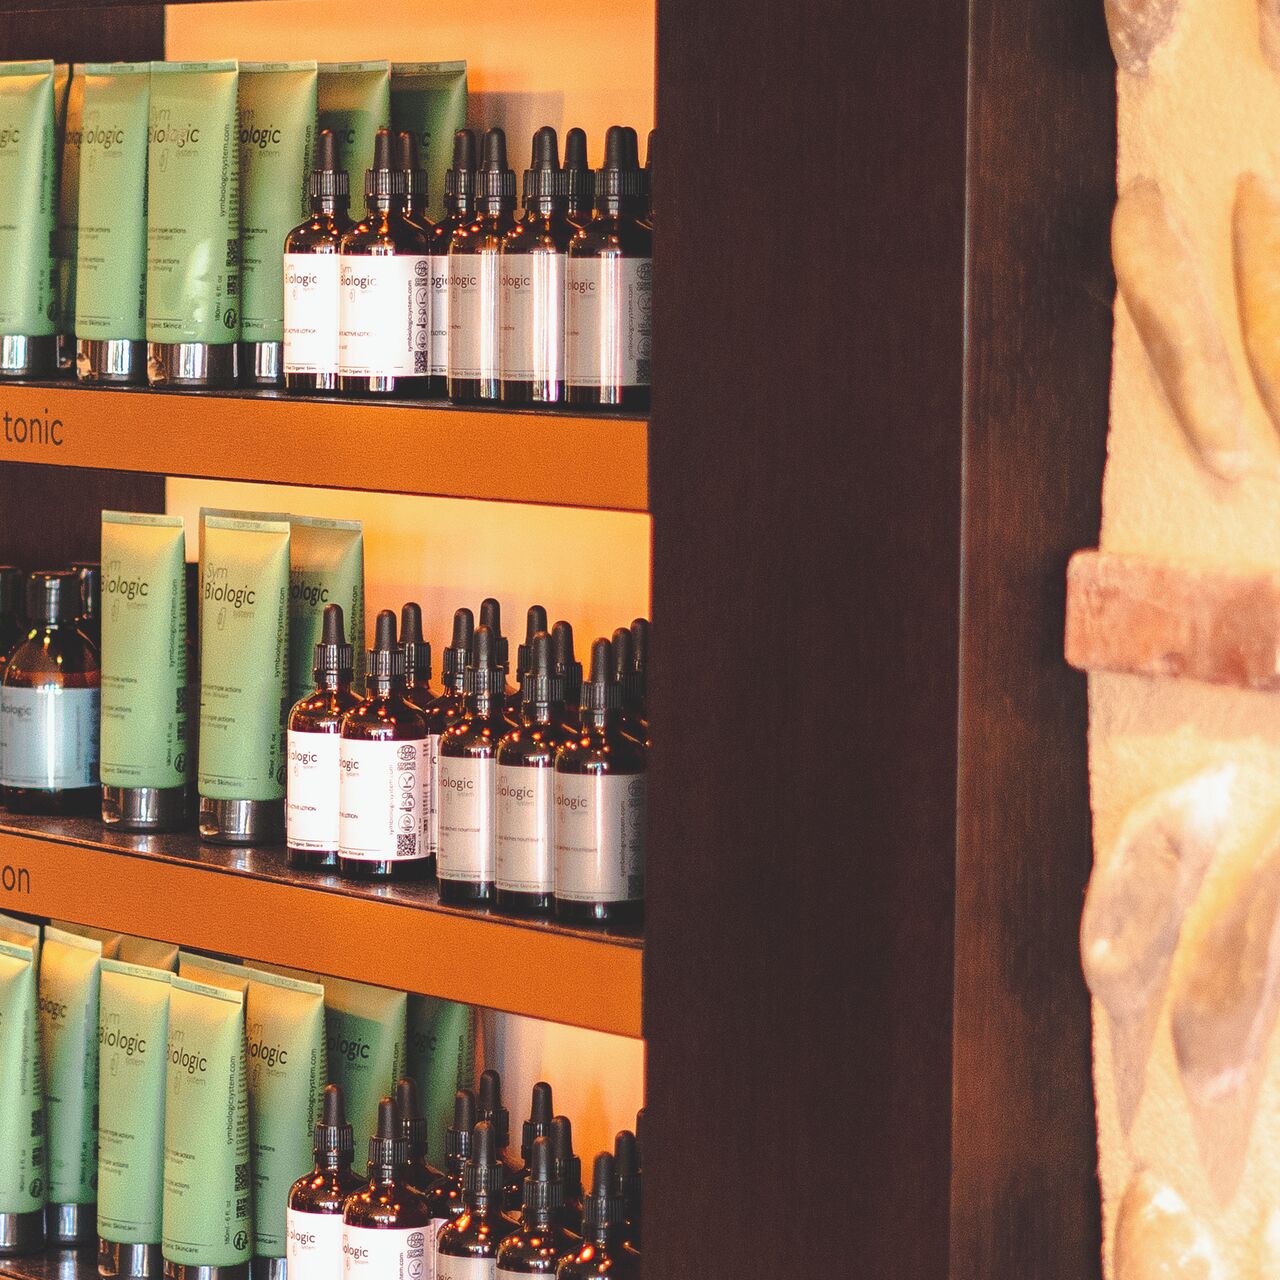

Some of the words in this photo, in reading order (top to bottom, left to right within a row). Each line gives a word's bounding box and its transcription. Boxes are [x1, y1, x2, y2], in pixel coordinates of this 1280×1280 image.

[2, 407, 65, 447] tonic
[204, 581, 256, 609] Biologic
[226, 1054, 237, 1146] symbiologicsystem.com
